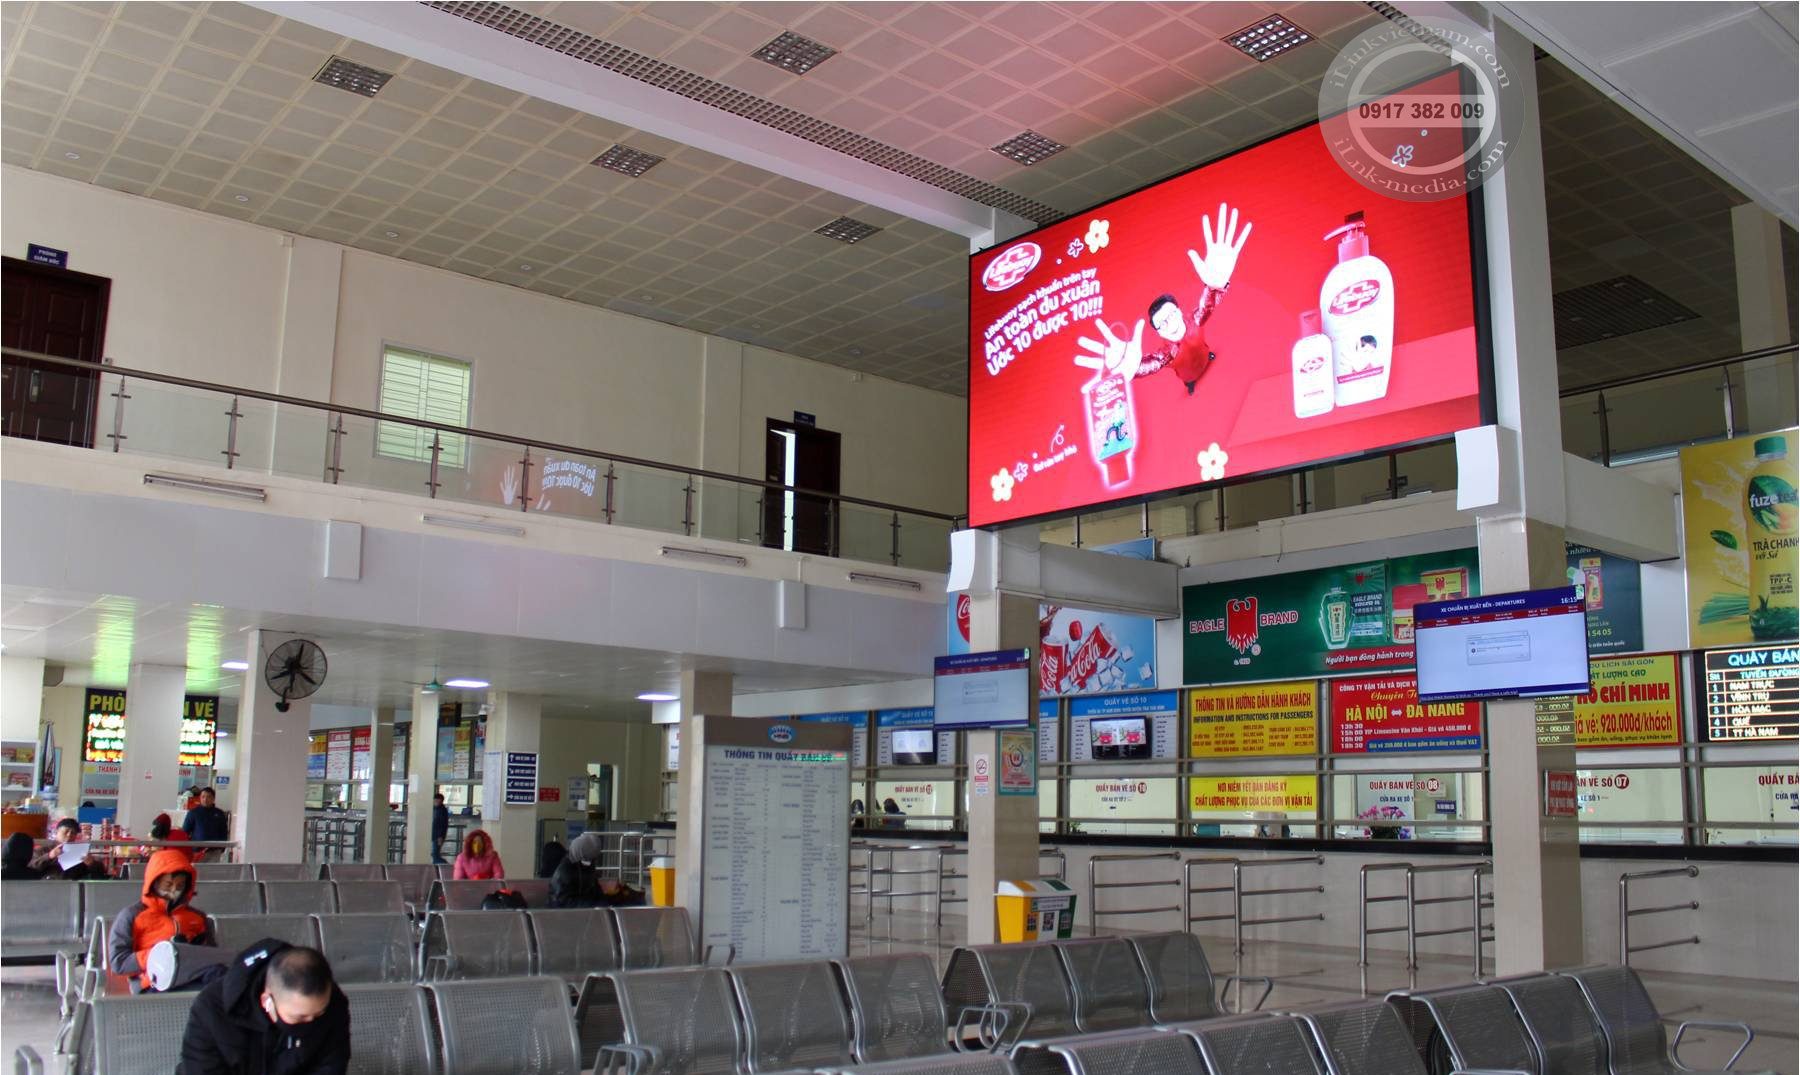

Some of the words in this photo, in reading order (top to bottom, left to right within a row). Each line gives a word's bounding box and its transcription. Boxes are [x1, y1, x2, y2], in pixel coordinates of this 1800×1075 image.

[985, 335, 1006, 360] An
[1003, 309, 1038, 340] toàn
[1039, 295, 1060, 316] du
[1060, 279, 1101, 306] xuân
[1012, 331, 1032, 352] 10
[1033, 312, 1069, 341] được
[1069, 296, 1104, 321] 10!!!
[1749, 494, 1778, 508] fuze
[1753, 538, 1769, 551] TRÀ
[1189, 618, 1225, 634] EAGLE
[1260, 610, 1299, 627] BRAND
[1345, 654, 1358, 664] bạn
[1376, 650, 1393, 660] hành
[1394, 650, 1414, 660] trong
[1630, 669, 1646, 677] CAO
[1339, 683, 1355, 692] CÔNG
[1356, 683, 1363, 691] TY
[1387, 680, 1395, 689] VÀ
[1600, 681, 1627, 704] CHÍ
[1628, 682, 1670, 702] MINH
[1729, 682, 1750, 690] NAM
[90, 692, 125, 712] PHÒ
[195, 700, 214, 718] VÉ
[1215, 698, 1227, 711] TIN
[1289, 690, 1311, 707] KHÁCH
[1270, 712, 1280, 720] FOR
[1280, 710, 1313, 719] PASSENGERS
[1345, 705, 1362, 721] HÀ
[1366, 703, 1388, 723] NỘI
[1585, 713, 1599, 734] vé:
[1714, 718, 1720, 726] 4
[1714, 729, 1720, 737] 5
[1758, 727, 1779, 736] NAM
[725, 750, 755, 760] THÔNG
[758, 752, 772, 761] TIN
